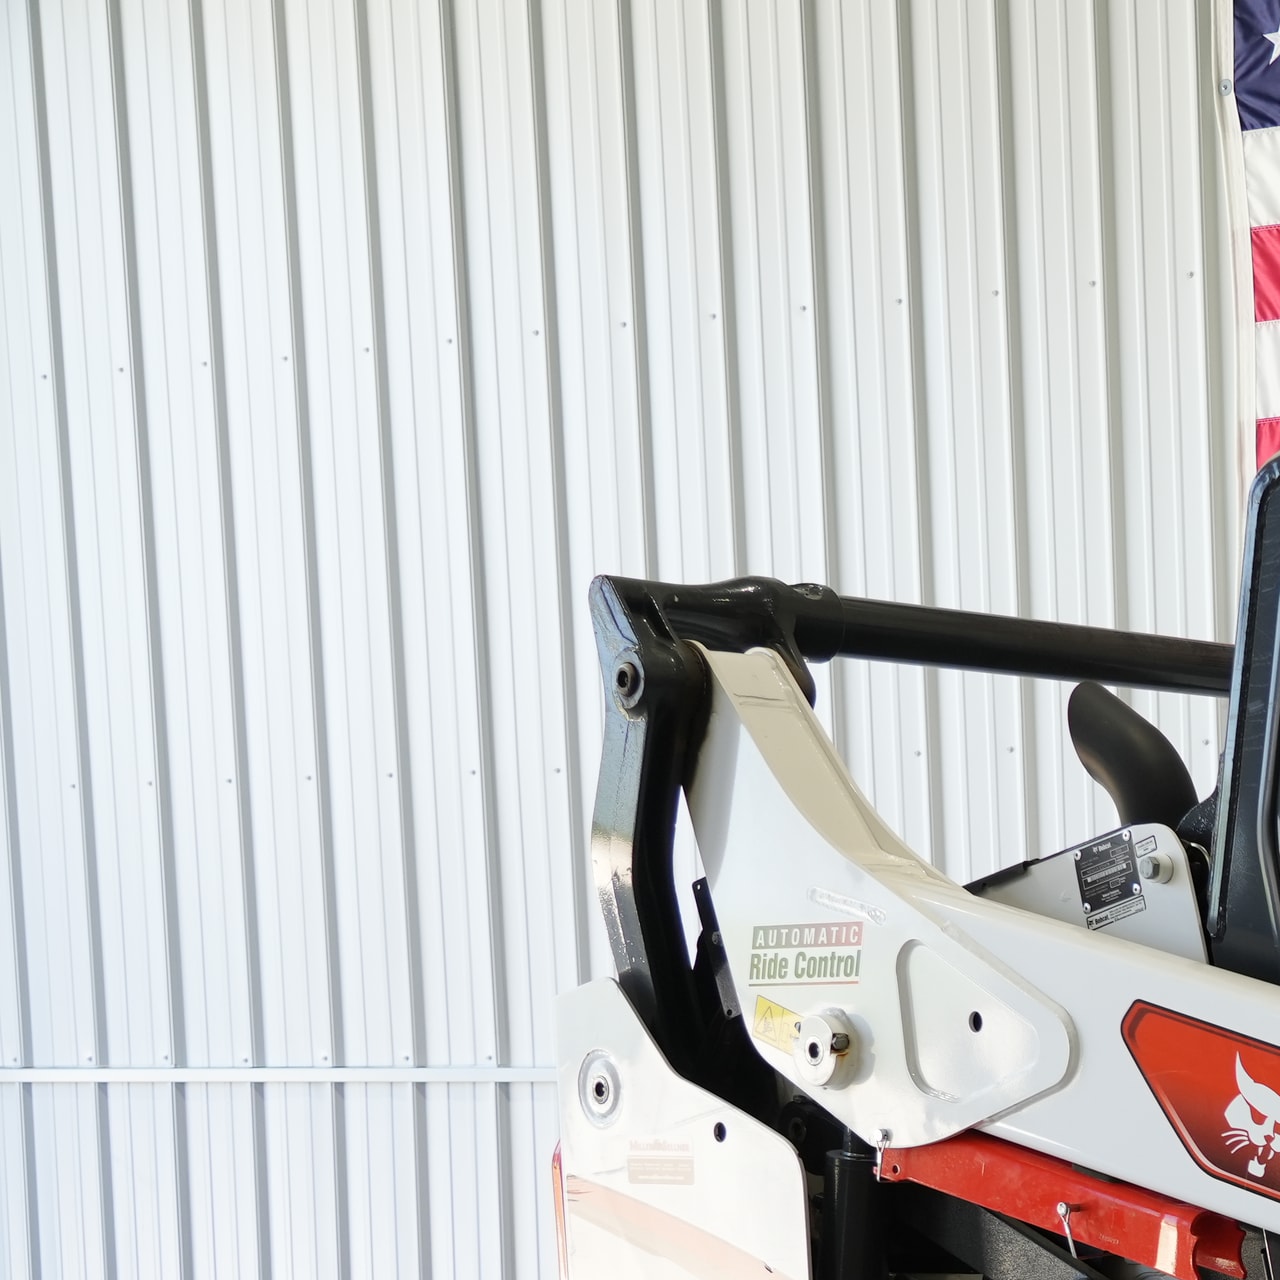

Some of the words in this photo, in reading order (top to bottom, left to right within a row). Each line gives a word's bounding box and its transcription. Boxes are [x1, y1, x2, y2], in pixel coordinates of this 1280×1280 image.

[756, 926, 859, 947] AUTOMATIC
[749, 952, 789, 980] Ride
[794, 949, 861, 979] Control
